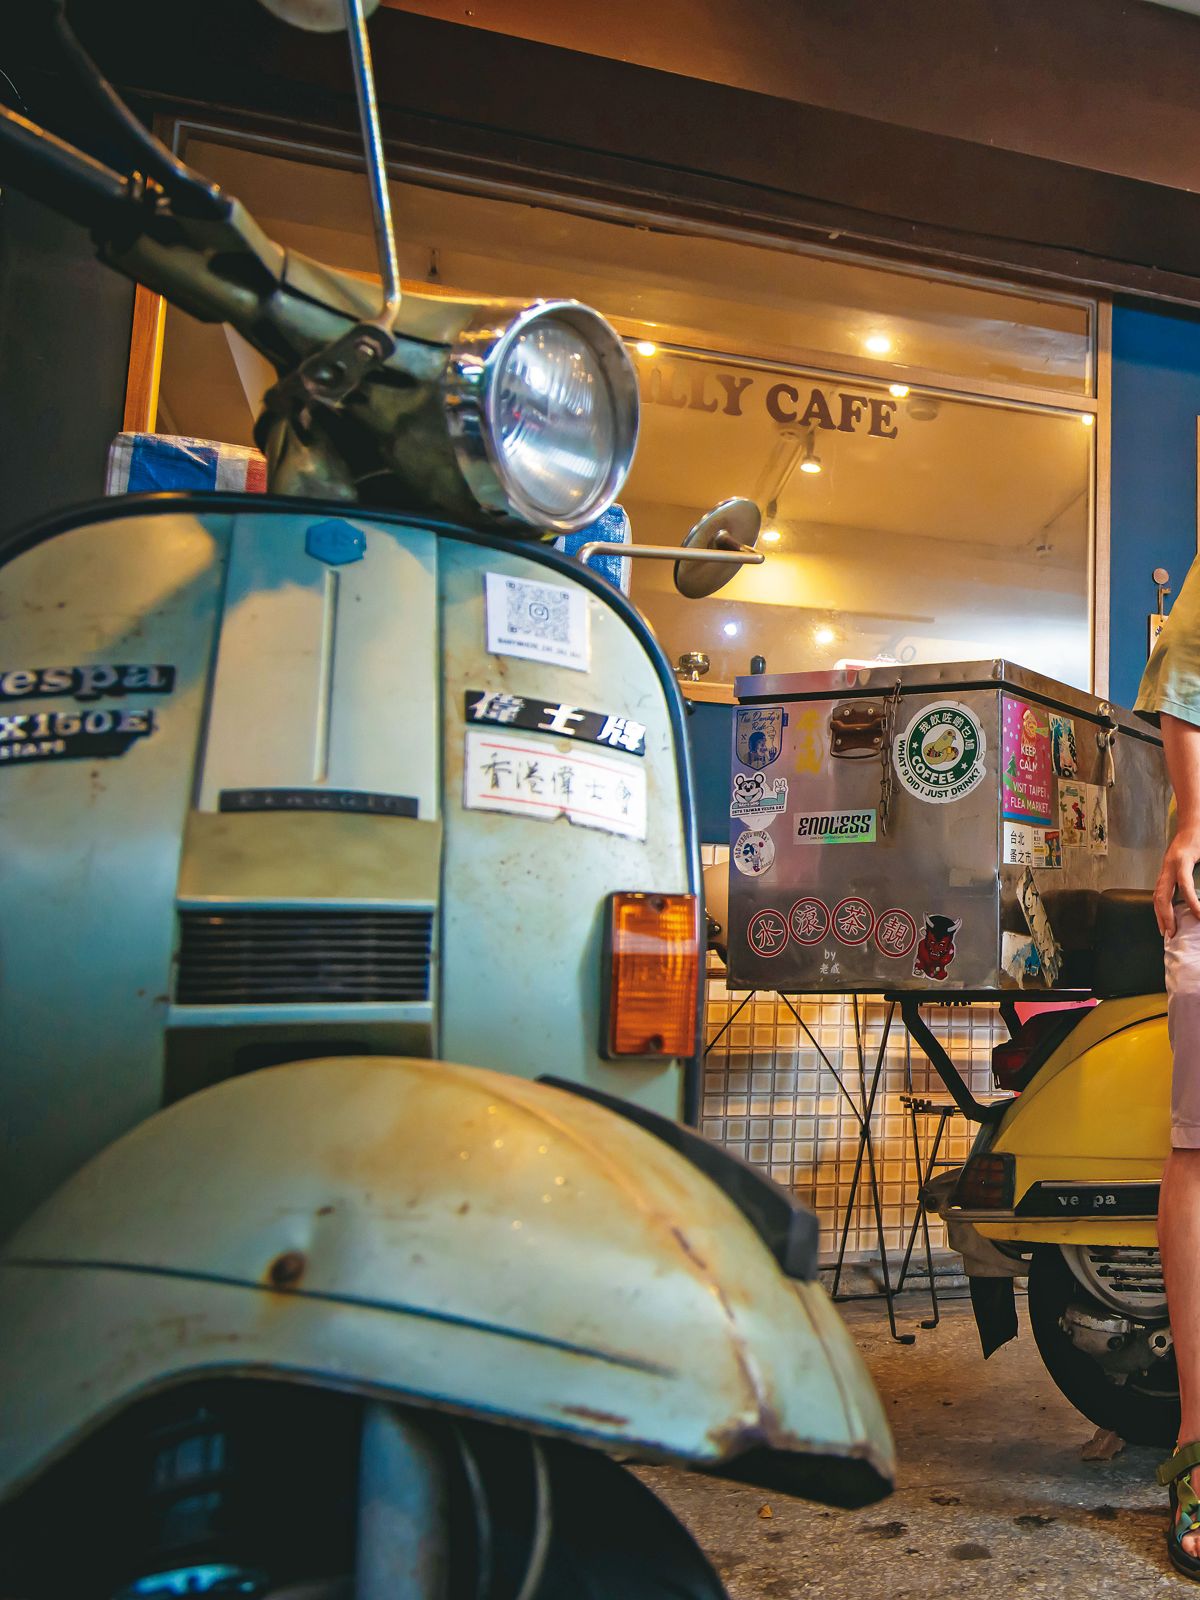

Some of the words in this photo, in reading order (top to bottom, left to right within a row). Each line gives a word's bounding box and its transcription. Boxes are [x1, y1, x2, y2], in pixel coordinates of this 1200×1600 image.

[766, 383, 898, 440] CAFE
[1020, 743, 1037, 758] KEEP
[898, 739, 907, 768] WHAT
[906, 776, 921, 790] DID
[919, 786, 925, 794] I
[925, 789, 949, 799] JUST
[951, 768, 981, 796] DRINK?
[911, 755, 956, 785] COFFEE
[1019, 759, 1038, 773] CALM
[1012, 781, 1028, 794] VISIT
[1029, 784, 1047, 798] TAIPEI
[1010, 796, 1026, 810] FLEA
[1027, 799, 1049, 814] MARKET
[798, 814, 872, 836] ENDLESS
[1010, 830, 1025, 845] 台北
[1009, 848, 1032, 864] 蚤之市
[824, 949, 837, 961] by
